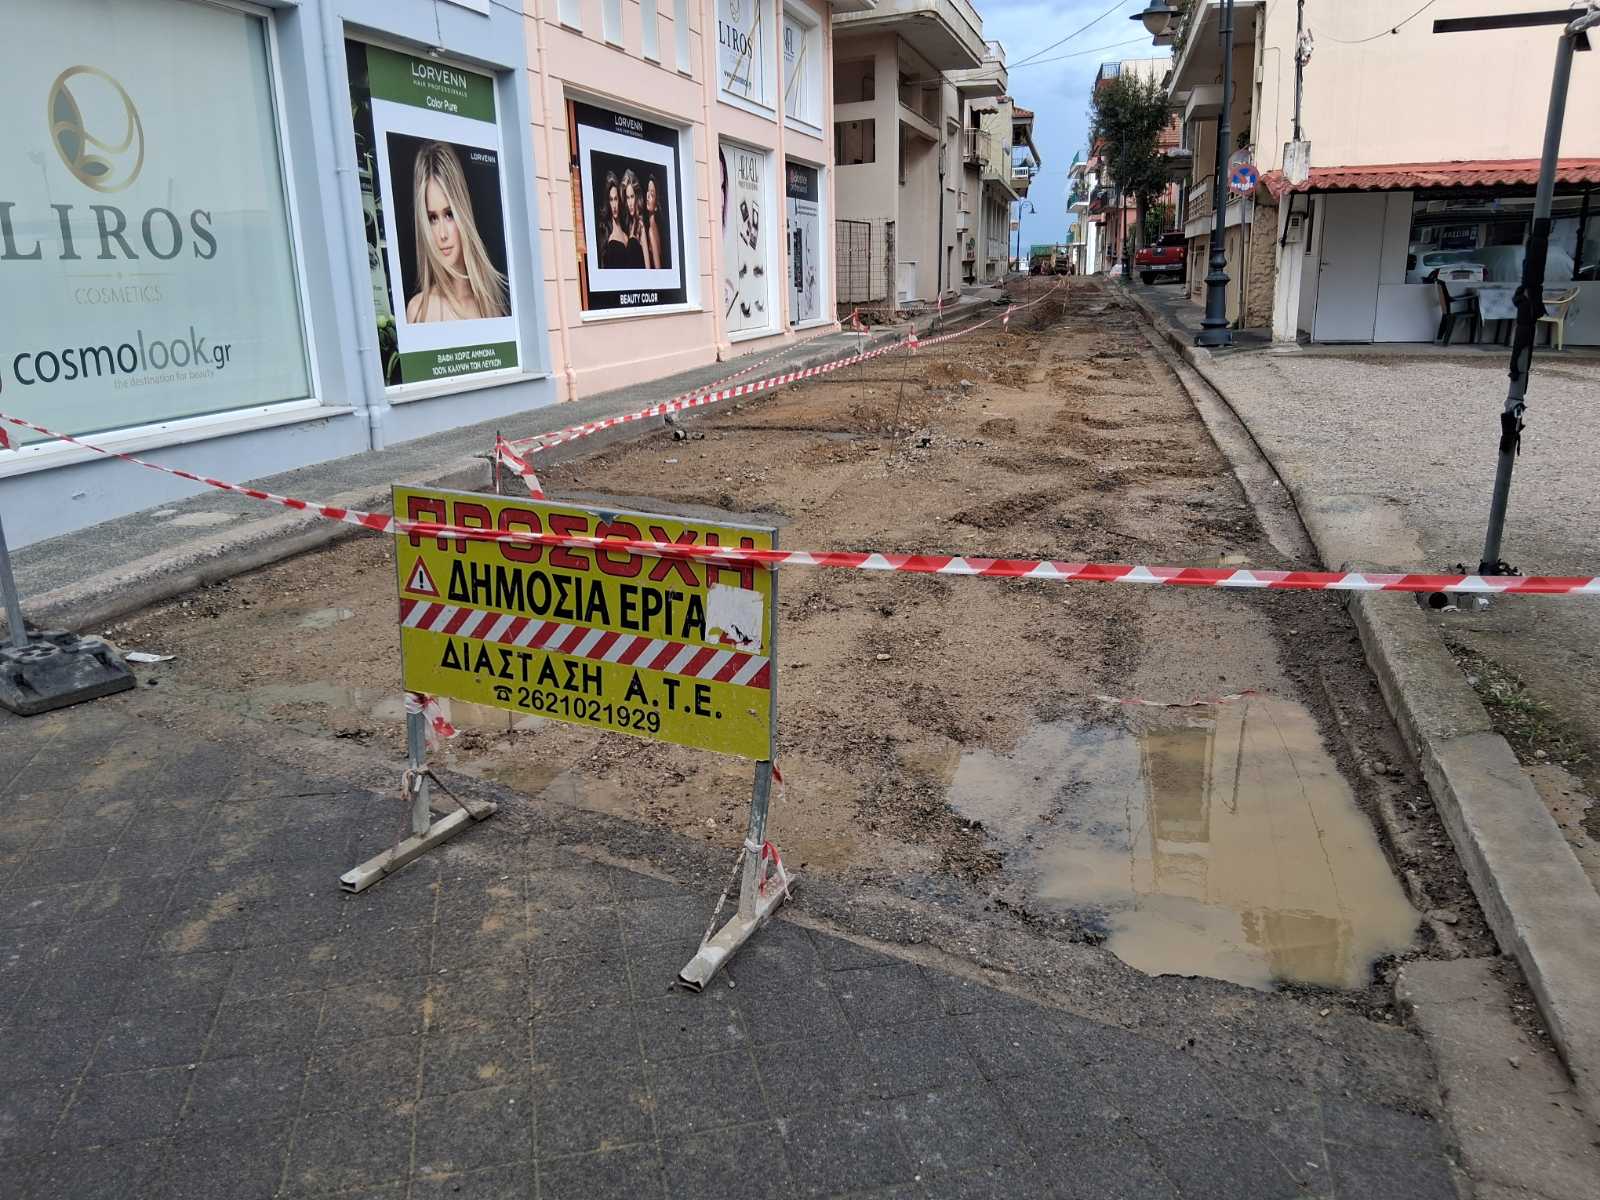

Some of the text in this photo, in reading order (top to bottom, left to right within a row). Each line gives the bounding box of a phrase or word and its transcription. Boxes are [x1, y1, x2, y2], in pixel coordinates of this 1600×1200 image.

[718, 20, 753, 60] LIROS
[411, 62, 467, 88] LORVENN
[426, 95, 458, 112] Color Pure
[614, 115, 643, 132] LORVENN
[470, 152, 496, 163] LORVENN
[0, 202, 217, 260] LIROS
[74, 285, 163, 304] COSMETICS
[620, 292, 658, 305] BEAUTY COLOR
[13, 326, 232, 386] cosmolook.gr
[454, 351, 471, 361] ΧΩΡΙΣ
[432, 366, 447, 376] 100%
[407, 496, 755, 590] ΠΡΟΣΟΧΗ
[447, 559, 707, 641] ΔΗΜΟΣΙΑ ΕΡΓΑ
[440, 637, 724, 720] ΔΙΑΣΤΑΣΗ Α.Τ.Ε.
[517, 686, 661, 733] 2621021929
